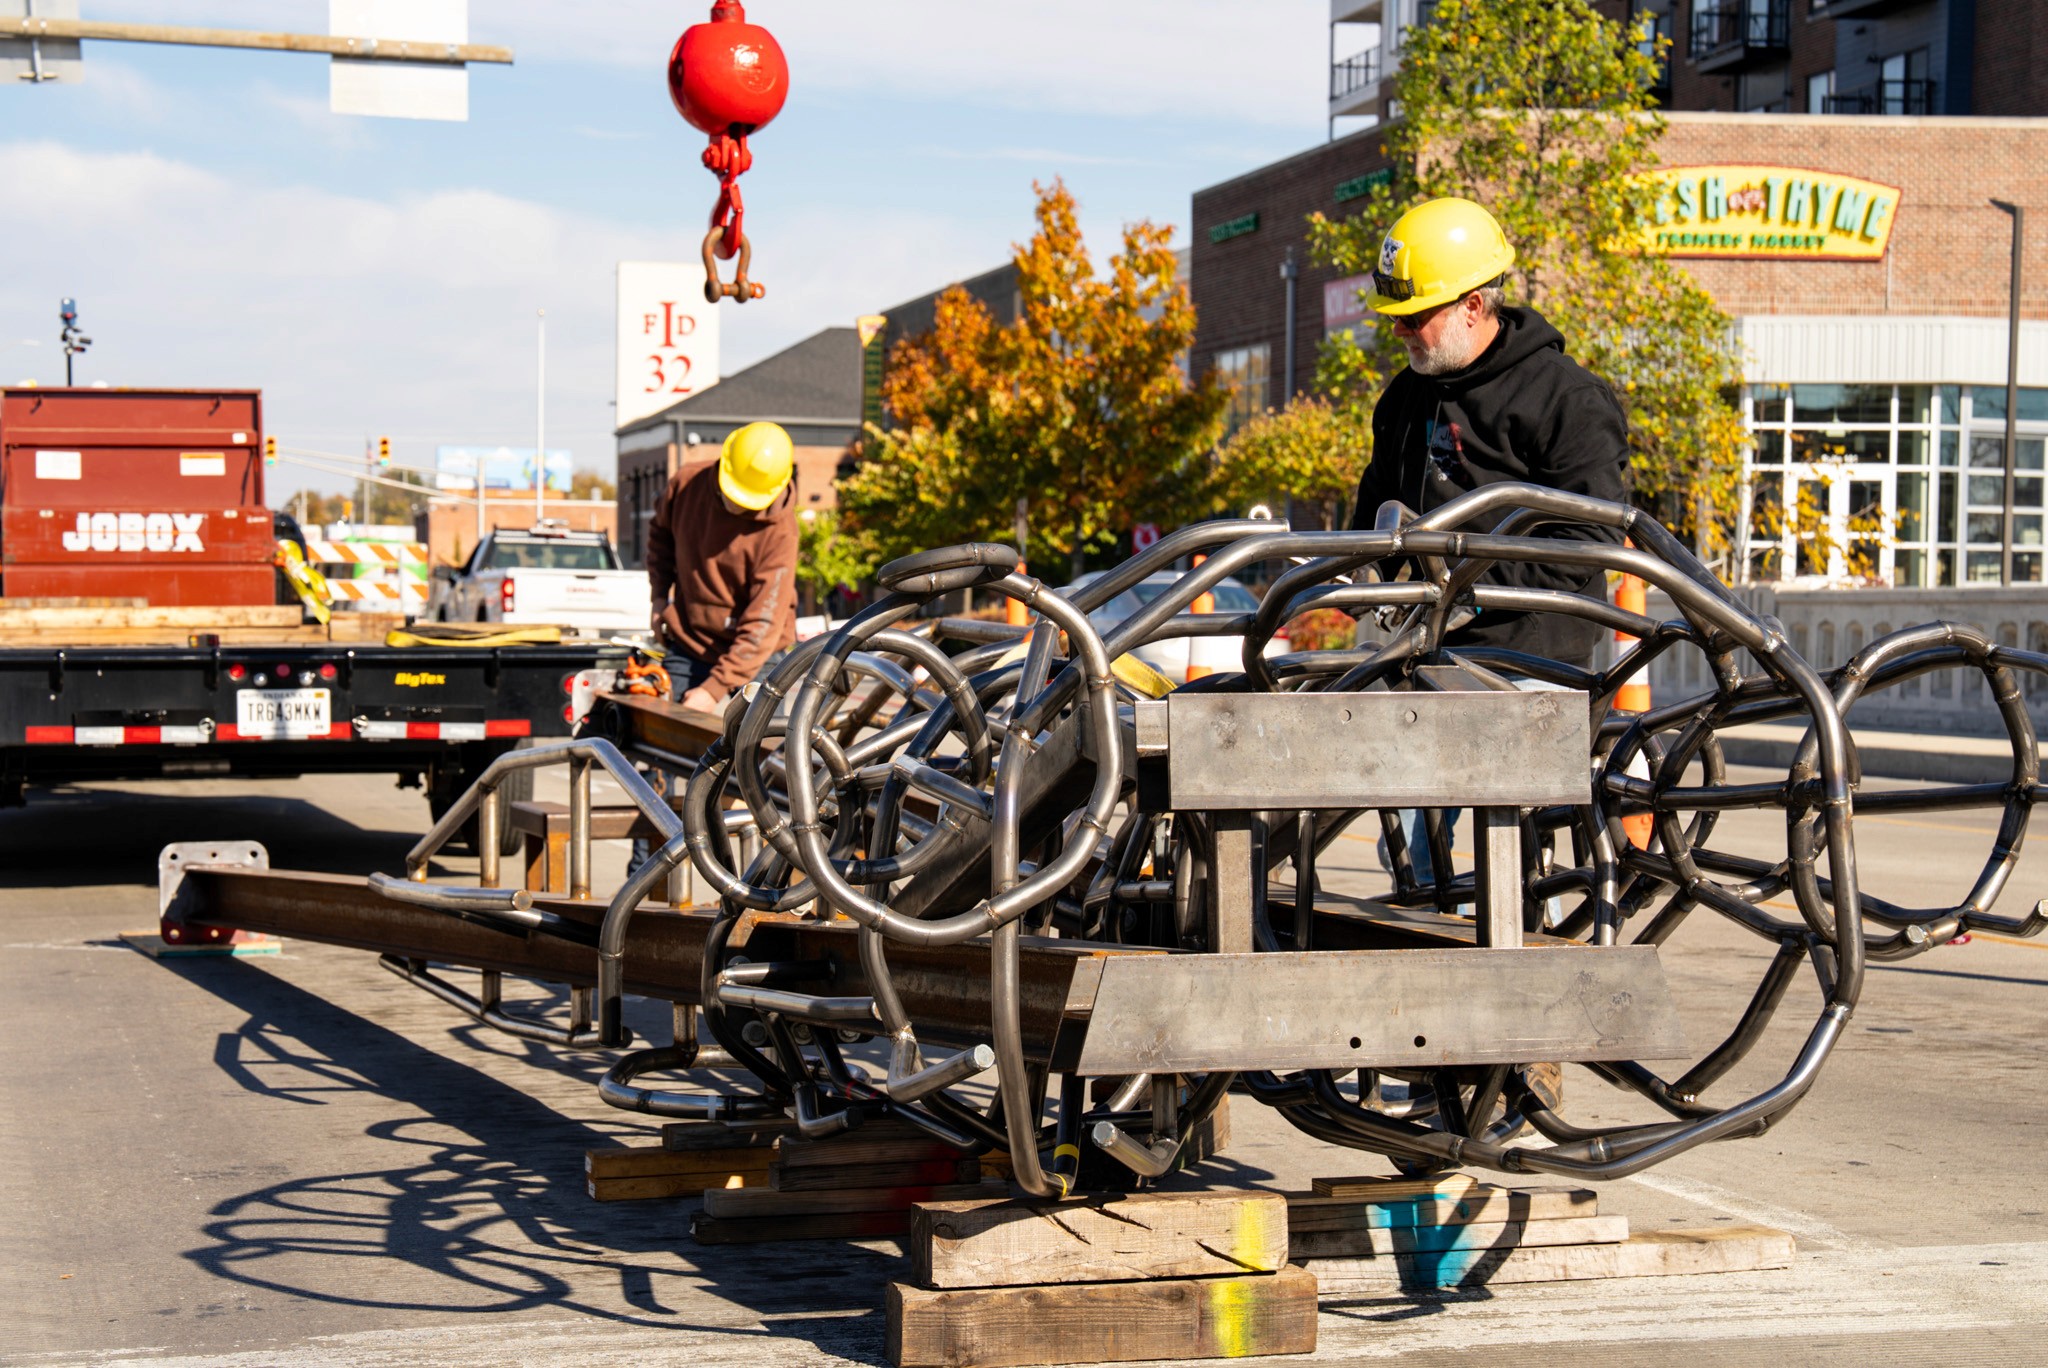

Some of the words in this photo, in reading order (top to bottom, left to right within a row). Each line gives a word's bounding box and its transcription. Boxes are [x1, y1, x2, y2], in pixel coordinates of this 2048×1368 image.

[1765, 176, 1891, 238] THYME
[1752, 234, 1826, 247] MARKET
[643, 354, 693, 394] 32
[62, 512, 205, 552] JOBOX
